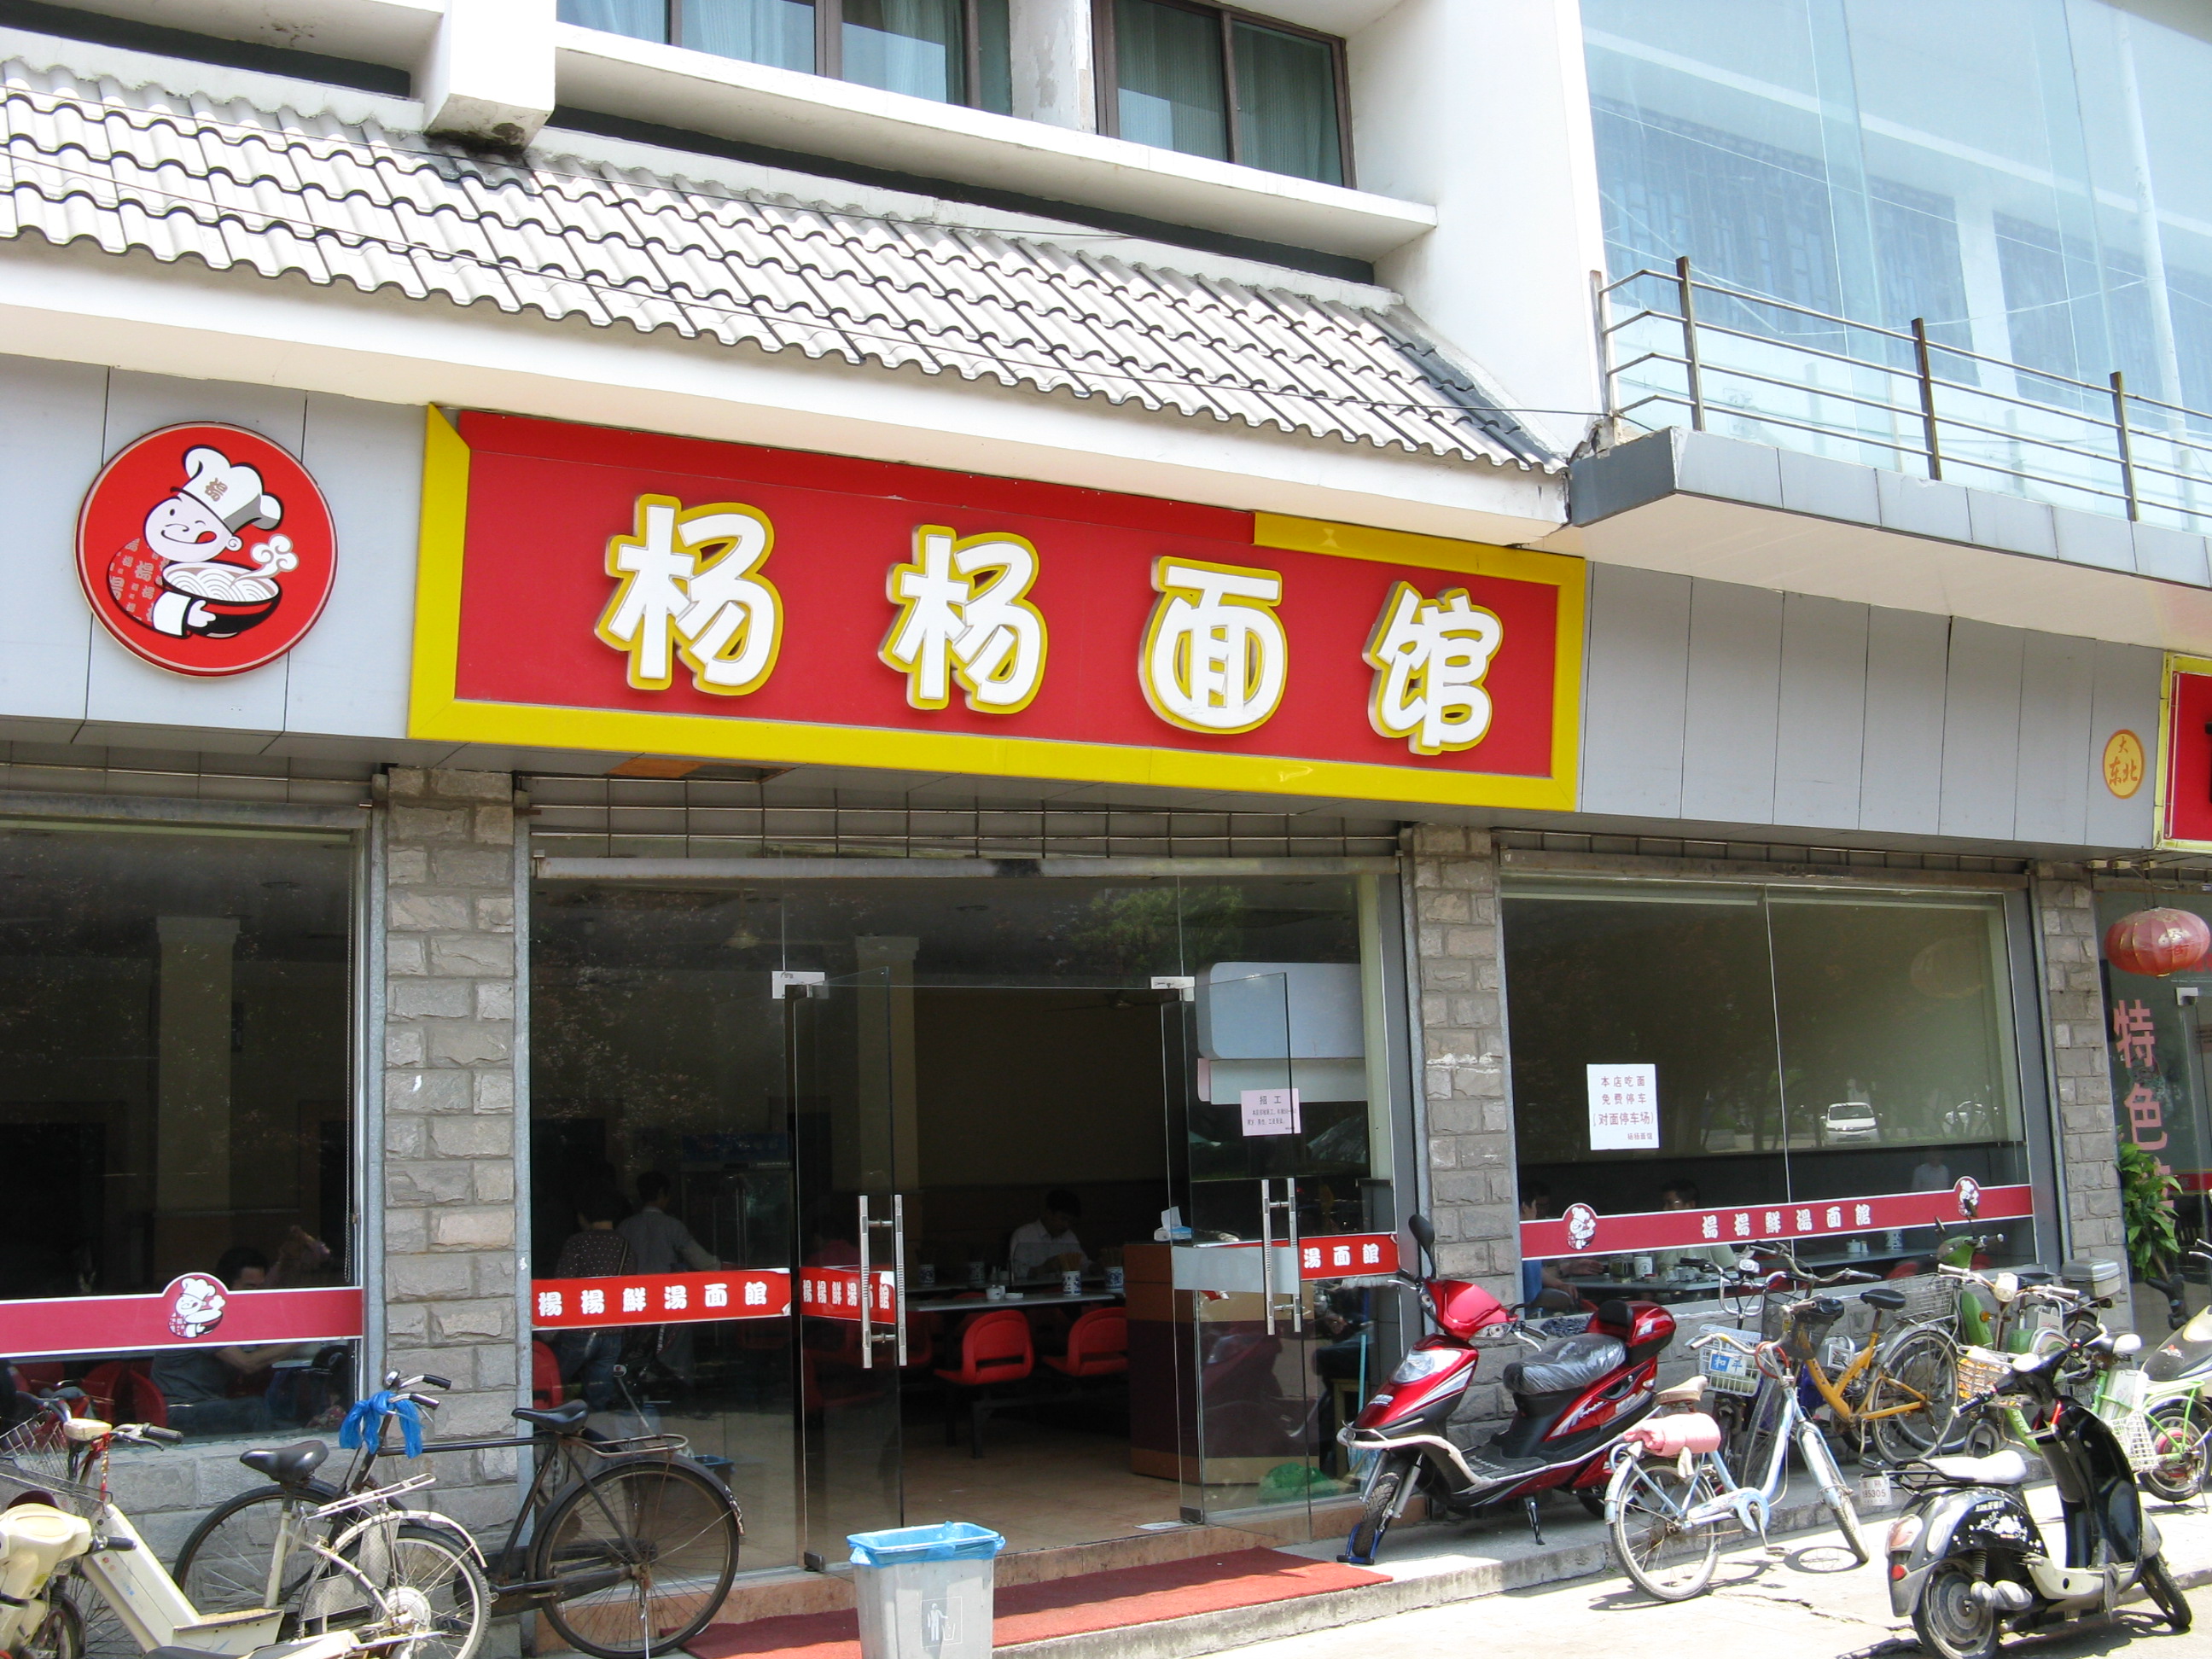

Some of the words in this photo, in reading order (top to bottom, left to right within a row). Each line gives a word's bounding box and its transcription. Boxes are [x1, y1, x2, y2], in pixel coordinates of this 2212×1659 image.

[595, 492, 1505, 756] 杨杨面馆
[1600, 1075, 1645, 1088] 本店吃面
[1260, 1095, 1283, 1106] 招工
[1602, 1093, 1647, 1105] 免费停车
[538, 1281, 767, 1318] 楊楊鮮湯面館
